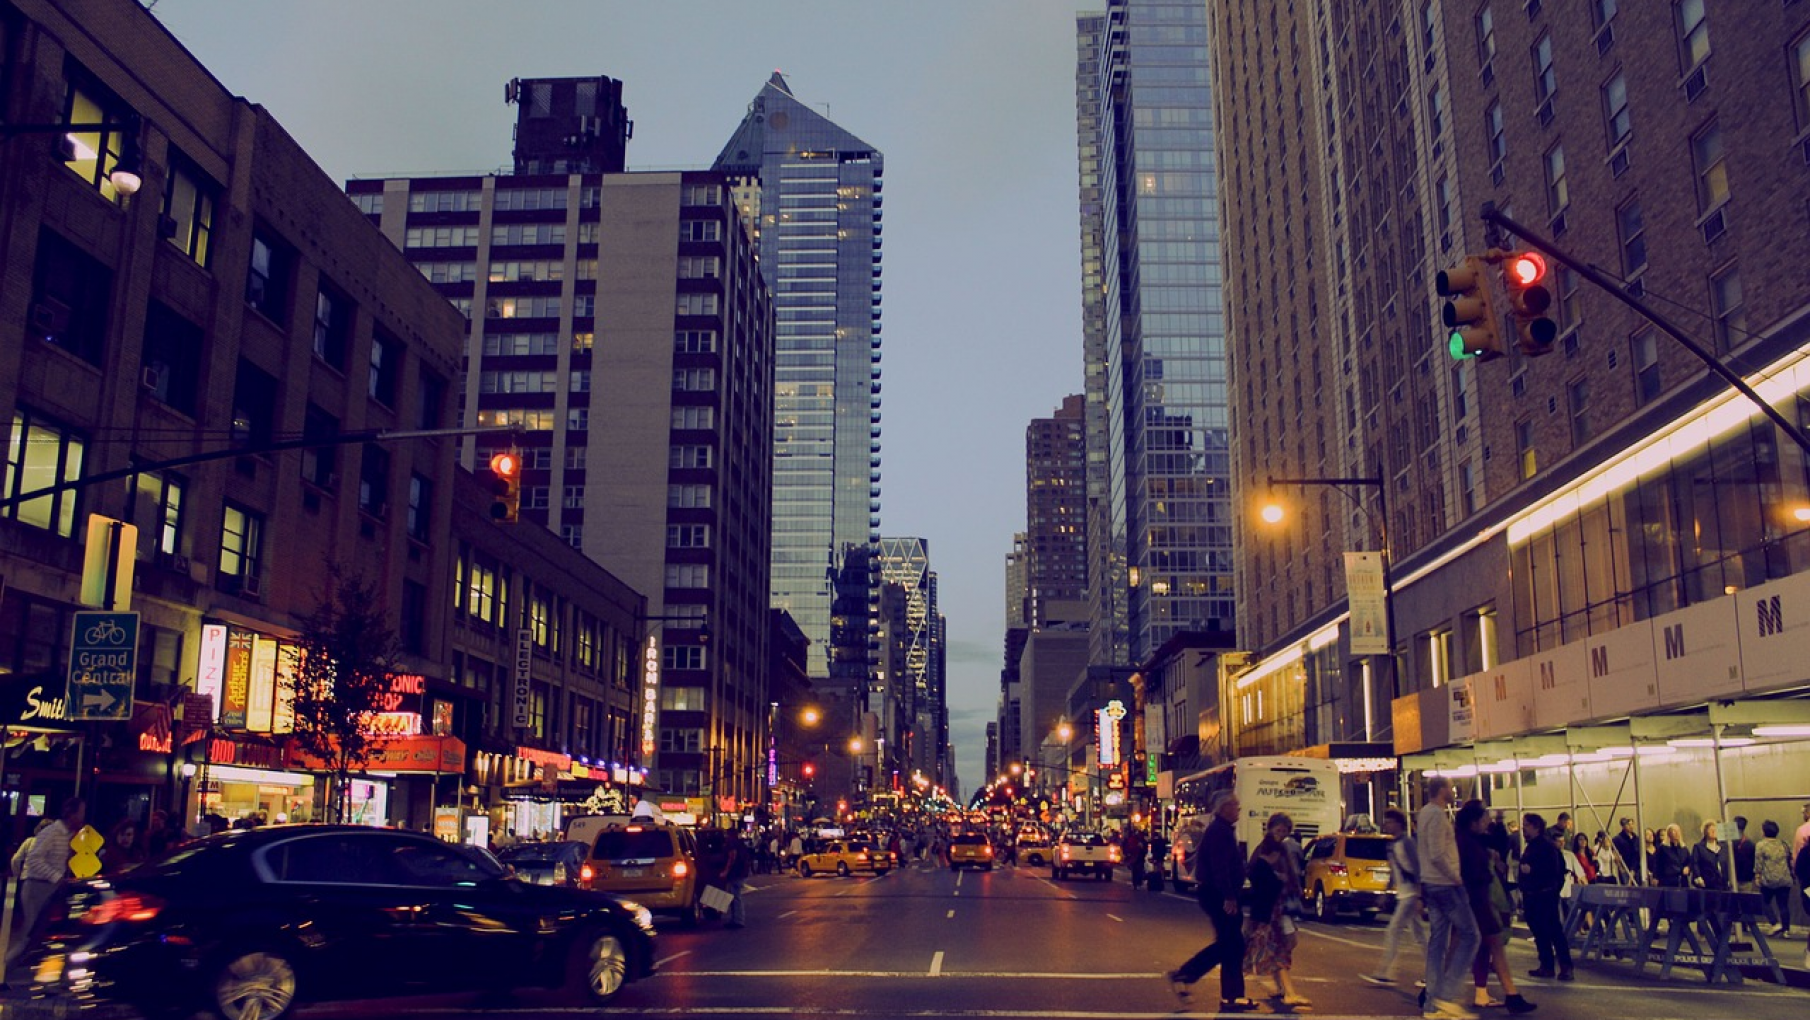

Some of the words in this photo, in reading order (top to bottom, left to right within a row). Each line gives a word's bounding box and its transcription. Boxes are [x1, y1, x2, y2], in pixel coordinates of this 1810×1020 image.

[1756, 594, 1783, 637] M
[1664, 623, 1685, 660] M
[80, 652, 127, 666] Grand
[205, 629, 221, 698] PIZZ
[646, 635, 659, 684] IRON
[1540, 661, 1555, 690] M
[1591, 645, 1608, 678] M
[72, 669, 133, 685] Central
[516, 633, 530, 723] ELECTRONIC
[1495, 675, 1507, 701] M
[643, 688, 657, 722] BAR
[197, 781, 219, 789] AM
[1674, 955, 1699, 963] POLICE
